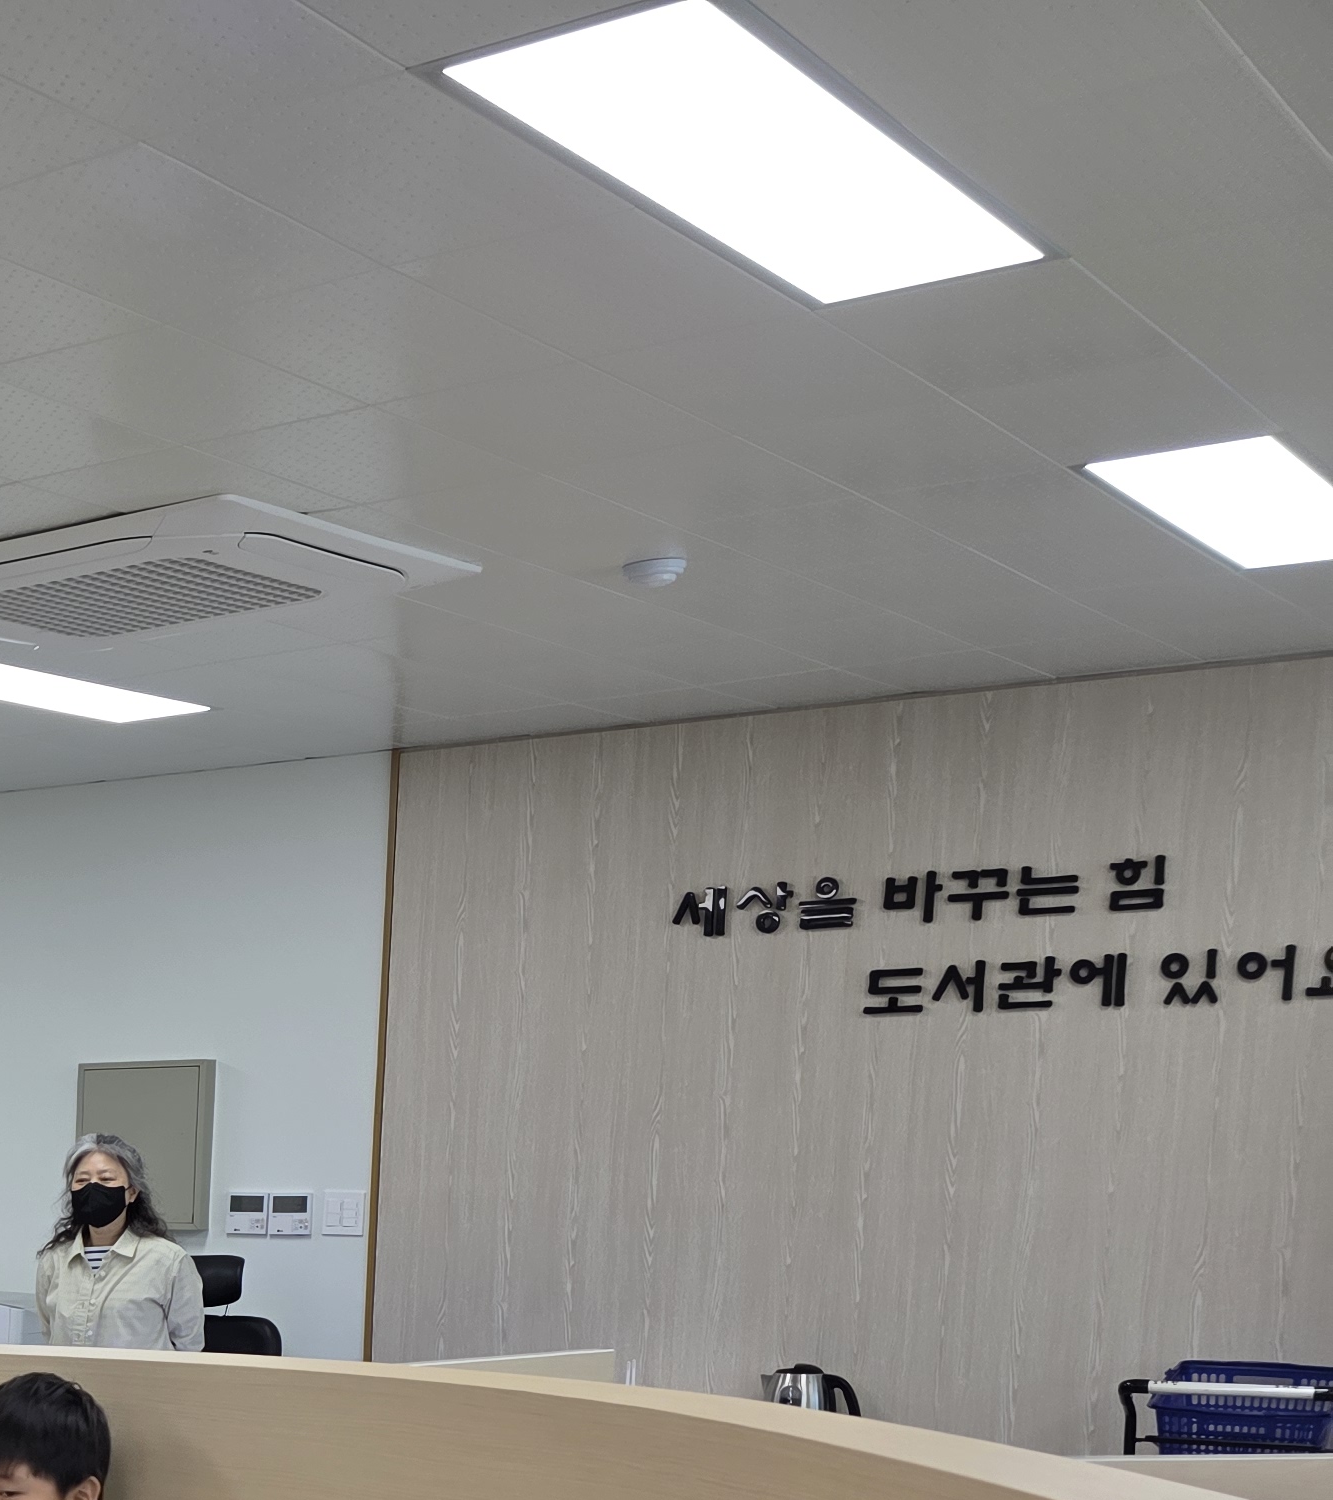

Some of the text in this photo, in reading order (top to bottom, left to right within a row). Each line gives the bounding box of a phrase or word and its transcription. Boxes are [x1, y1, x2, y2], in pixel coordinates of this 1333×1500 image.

[671, 854, 1167, 937] 세상을 바꾸는 힘
[862, 952, 1128, 1015] 도서관에
